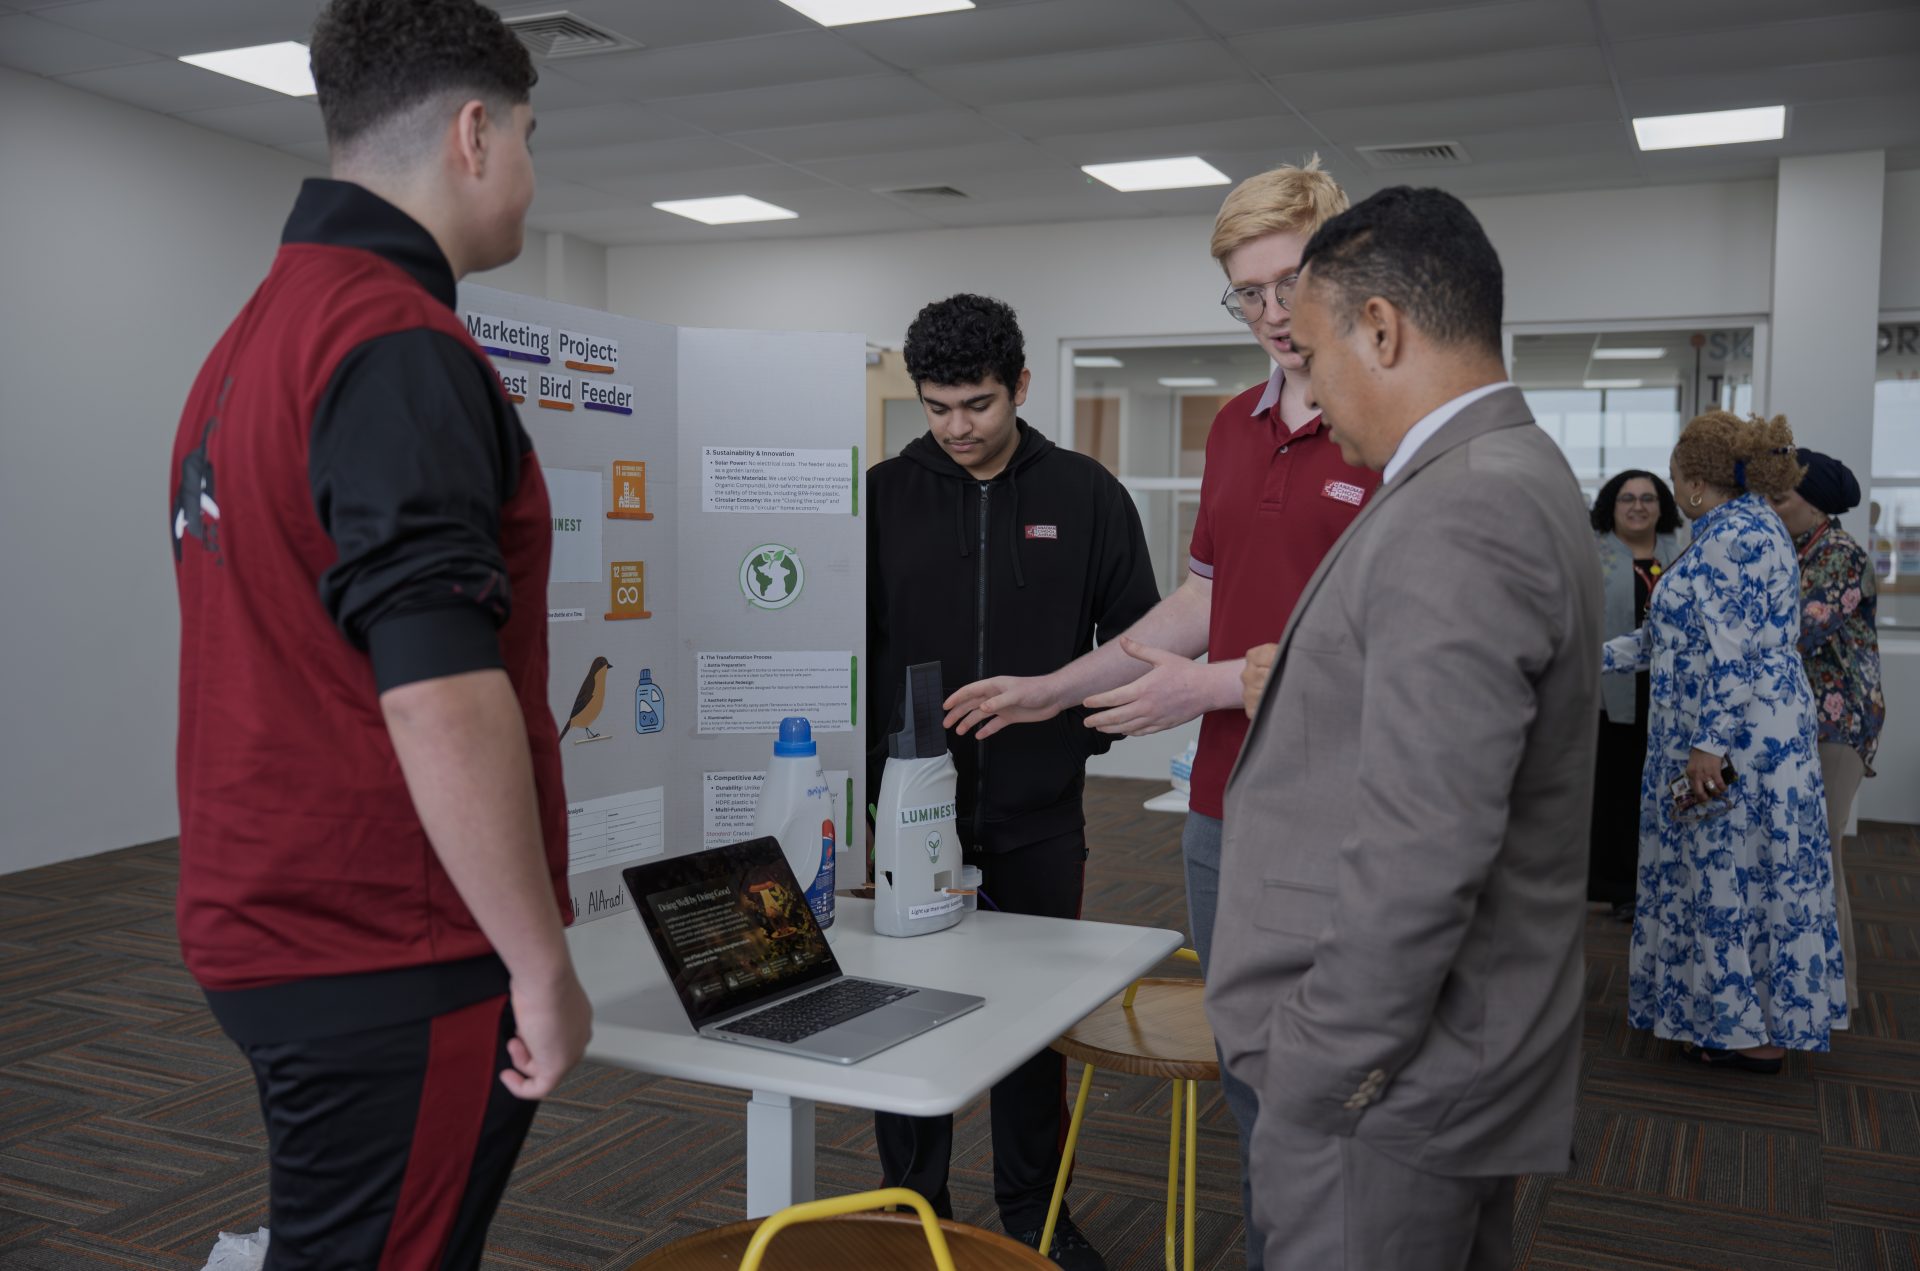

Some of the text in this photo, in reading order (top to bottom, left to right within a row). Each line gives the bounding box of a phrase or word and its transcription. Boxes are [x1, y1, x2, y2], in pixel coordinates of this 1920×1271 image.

[467, 314, 618, 363] Marketing Project:
[497, 371, 632, 408] est Bird Feeder
[712, 449, 755, 458] Sustainability
[714, 774, 751, 782] Competitive
[901, 803, 955, 824] LUMINEST
[588, 884, 625, 915] AlAradi
[657, 900, 679, 913] Doing
[696, 889, 716, 903] Doing
[714, 886, 731, 899] Good
